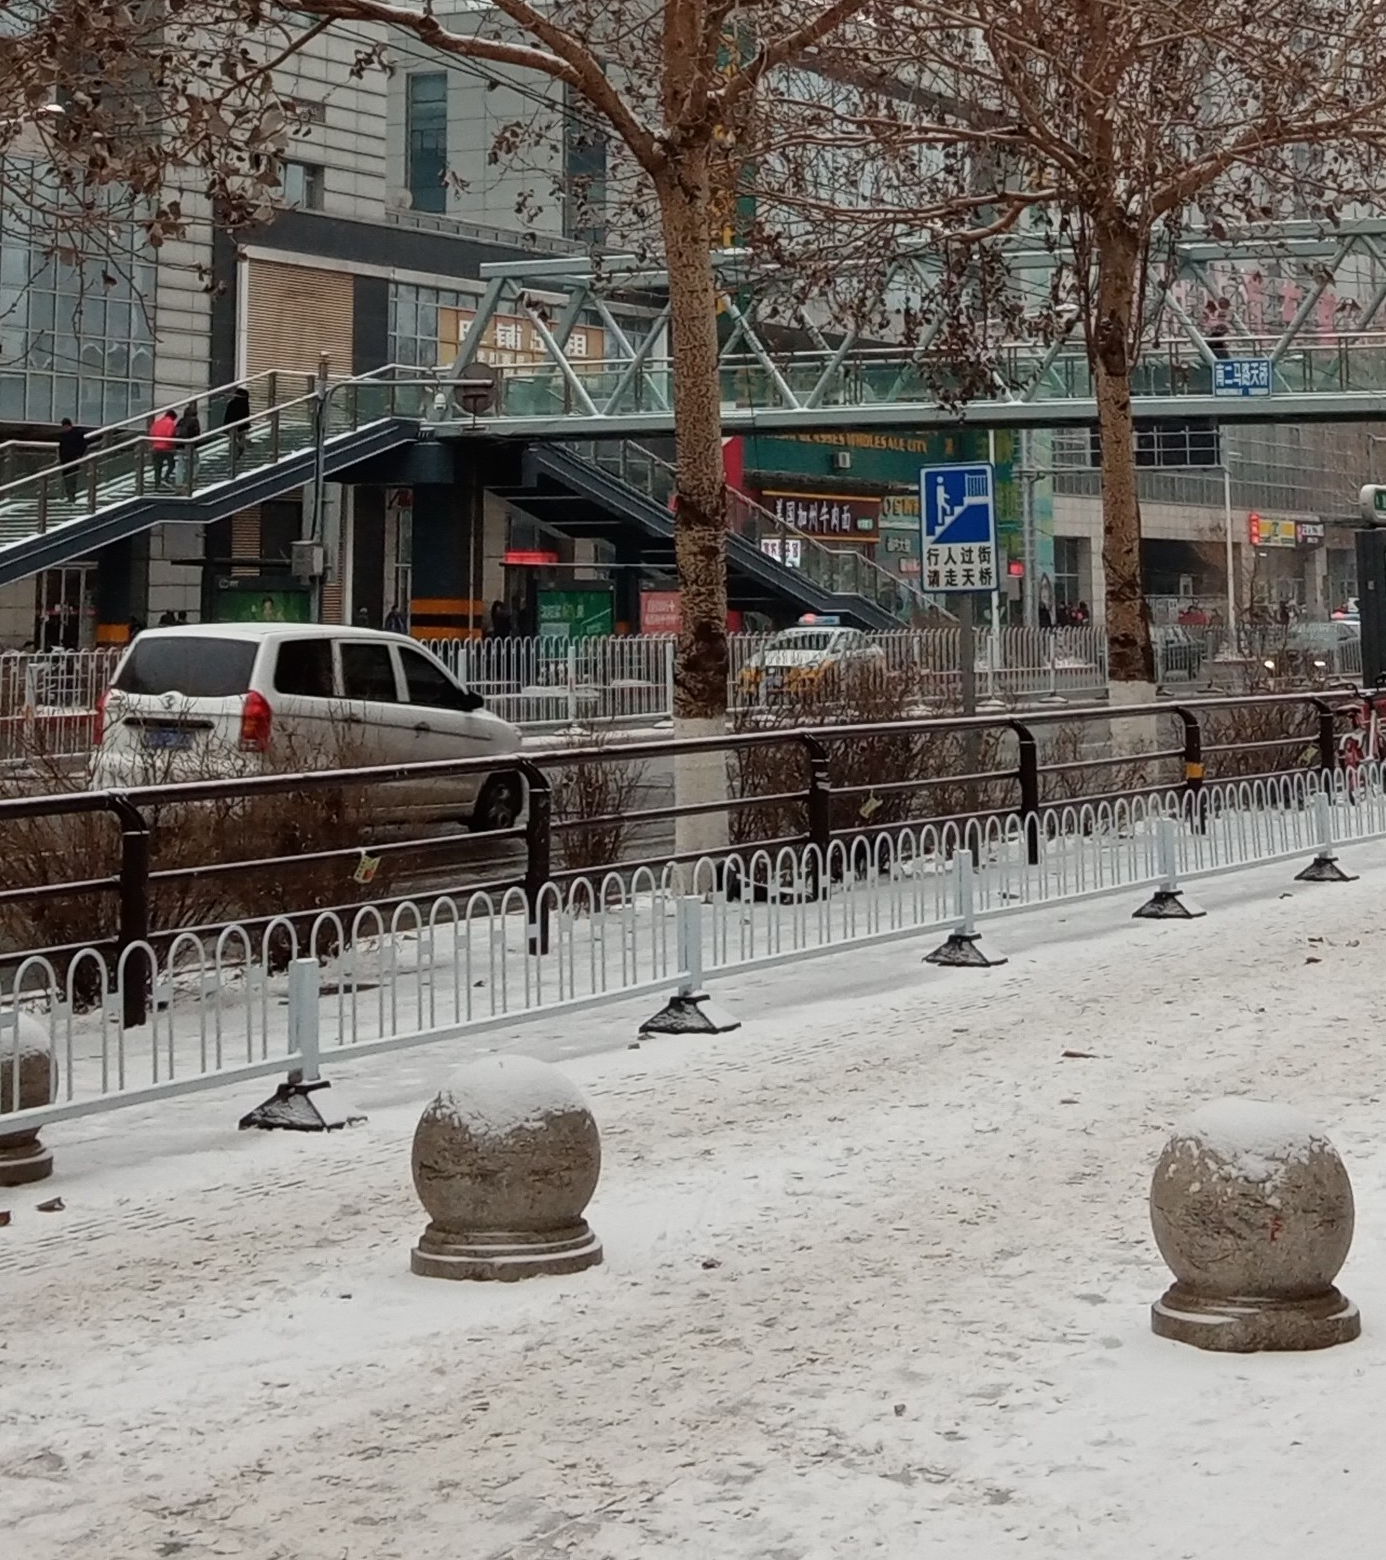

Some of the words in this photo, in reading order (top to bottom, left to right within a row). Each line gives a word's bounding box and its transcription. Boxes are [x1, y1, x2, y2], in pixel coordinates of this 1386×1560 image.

[774, 498, 852, 534] 美国加州牛肉面
[926, 545, 992, 567] 行人过街
[927, 567, 993, 588] 请走天桥
